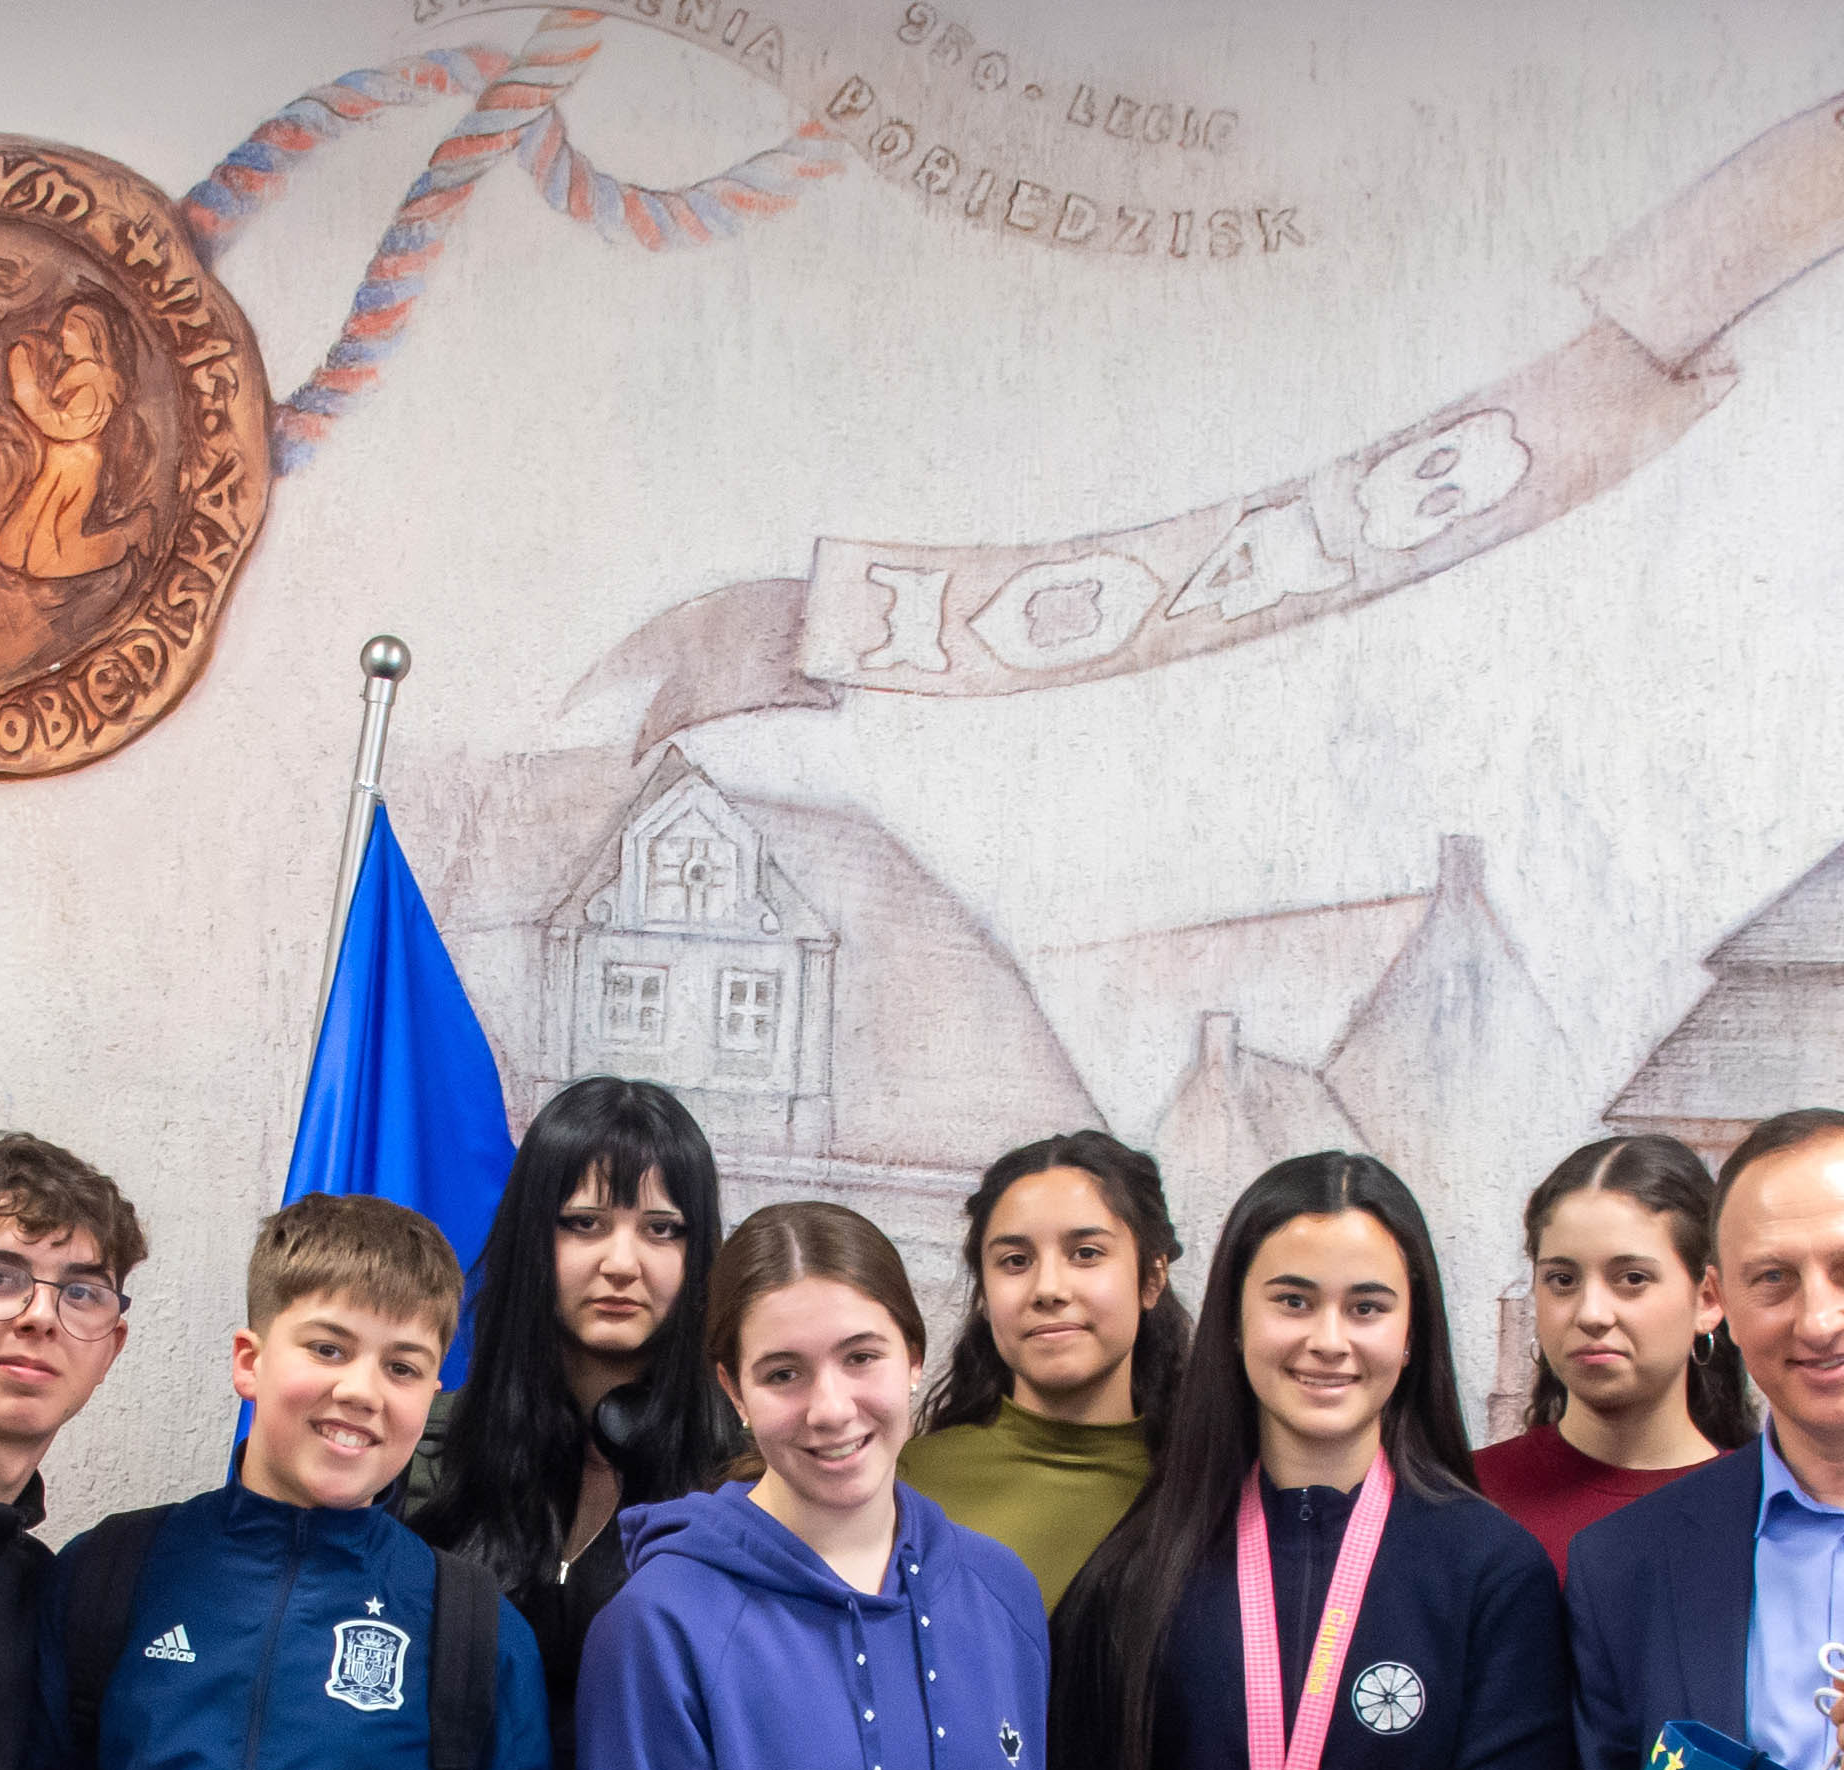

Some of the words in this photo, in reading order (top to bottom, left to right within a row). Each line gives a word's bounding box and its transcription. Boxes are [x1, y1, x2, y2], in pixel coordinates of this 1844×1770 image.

[824, 75, 1308, 259] POBIEDZISK
[858, 406, 1533, 674] 1048
[144, 1645, 197, 1663] adidas
[1307, 1607, 1348, 1695] Candela
